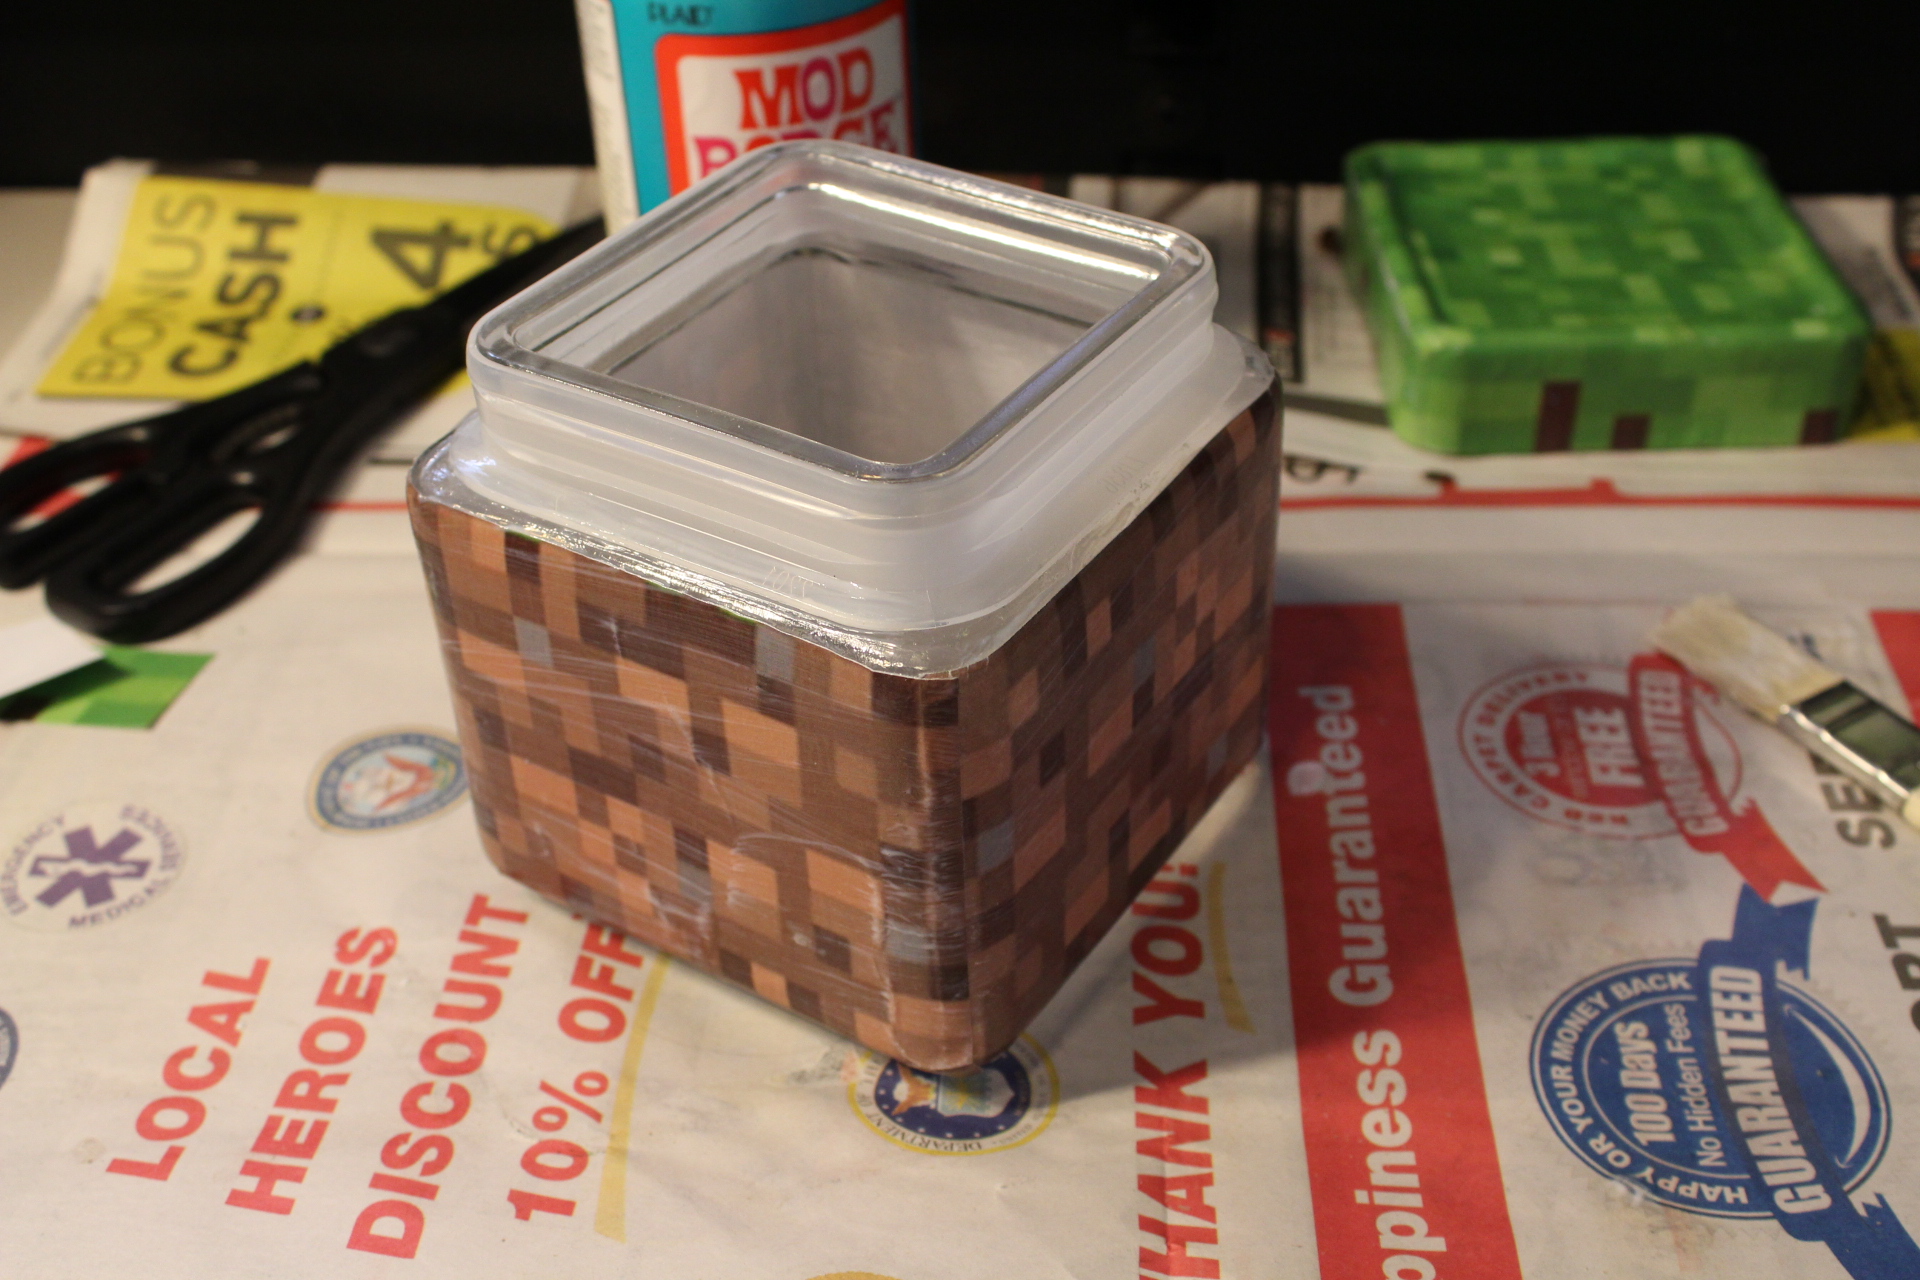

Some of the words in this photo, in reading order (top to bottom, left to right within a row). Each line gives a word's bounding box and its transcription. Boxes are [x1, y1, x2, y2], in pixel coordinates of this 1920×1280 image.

[733, 46, 875, 131] MOD
[71, 193, 219, 385] BONUS
[168, 209, 300, 378] CASH
[1572, 705, 1647, 787] FREE
[1298, 685, 1394, 1008] Guaranteed
[1130, 863, 1206, 1027] YOU!
[1551, 991, 1611, 1062] MONEY
[1609, 971, 1694, 1002] BACK
[1613, 1020, 1665, 1089] Days
[1663, 1003, 1697, 1053] Fees
[105, 957, 271, 1182] LOCAL
[225, 927, 399, 1216] HEROES
[346, 893, 530, 1260] DISCOUNT
[1550, 1065, 1595, 1134] YOUR
[1675, 1056, 1719, 1132] Hidden
[1708, 965, 1834, 1216] GUARANTEED
[507, 1070, 610, 1222] 10%
[867, 1112, 983, 1152] DEPARTMENT
[1588, 1132, 1632, 1170] OR
[1624, 1093, 1677, 1147] 100
[1696, 1136, 1728, 1168] No
[1133, 1050, 1221, 1280] HANK
[1637, 1166, 1750, 1206] HAPPY
